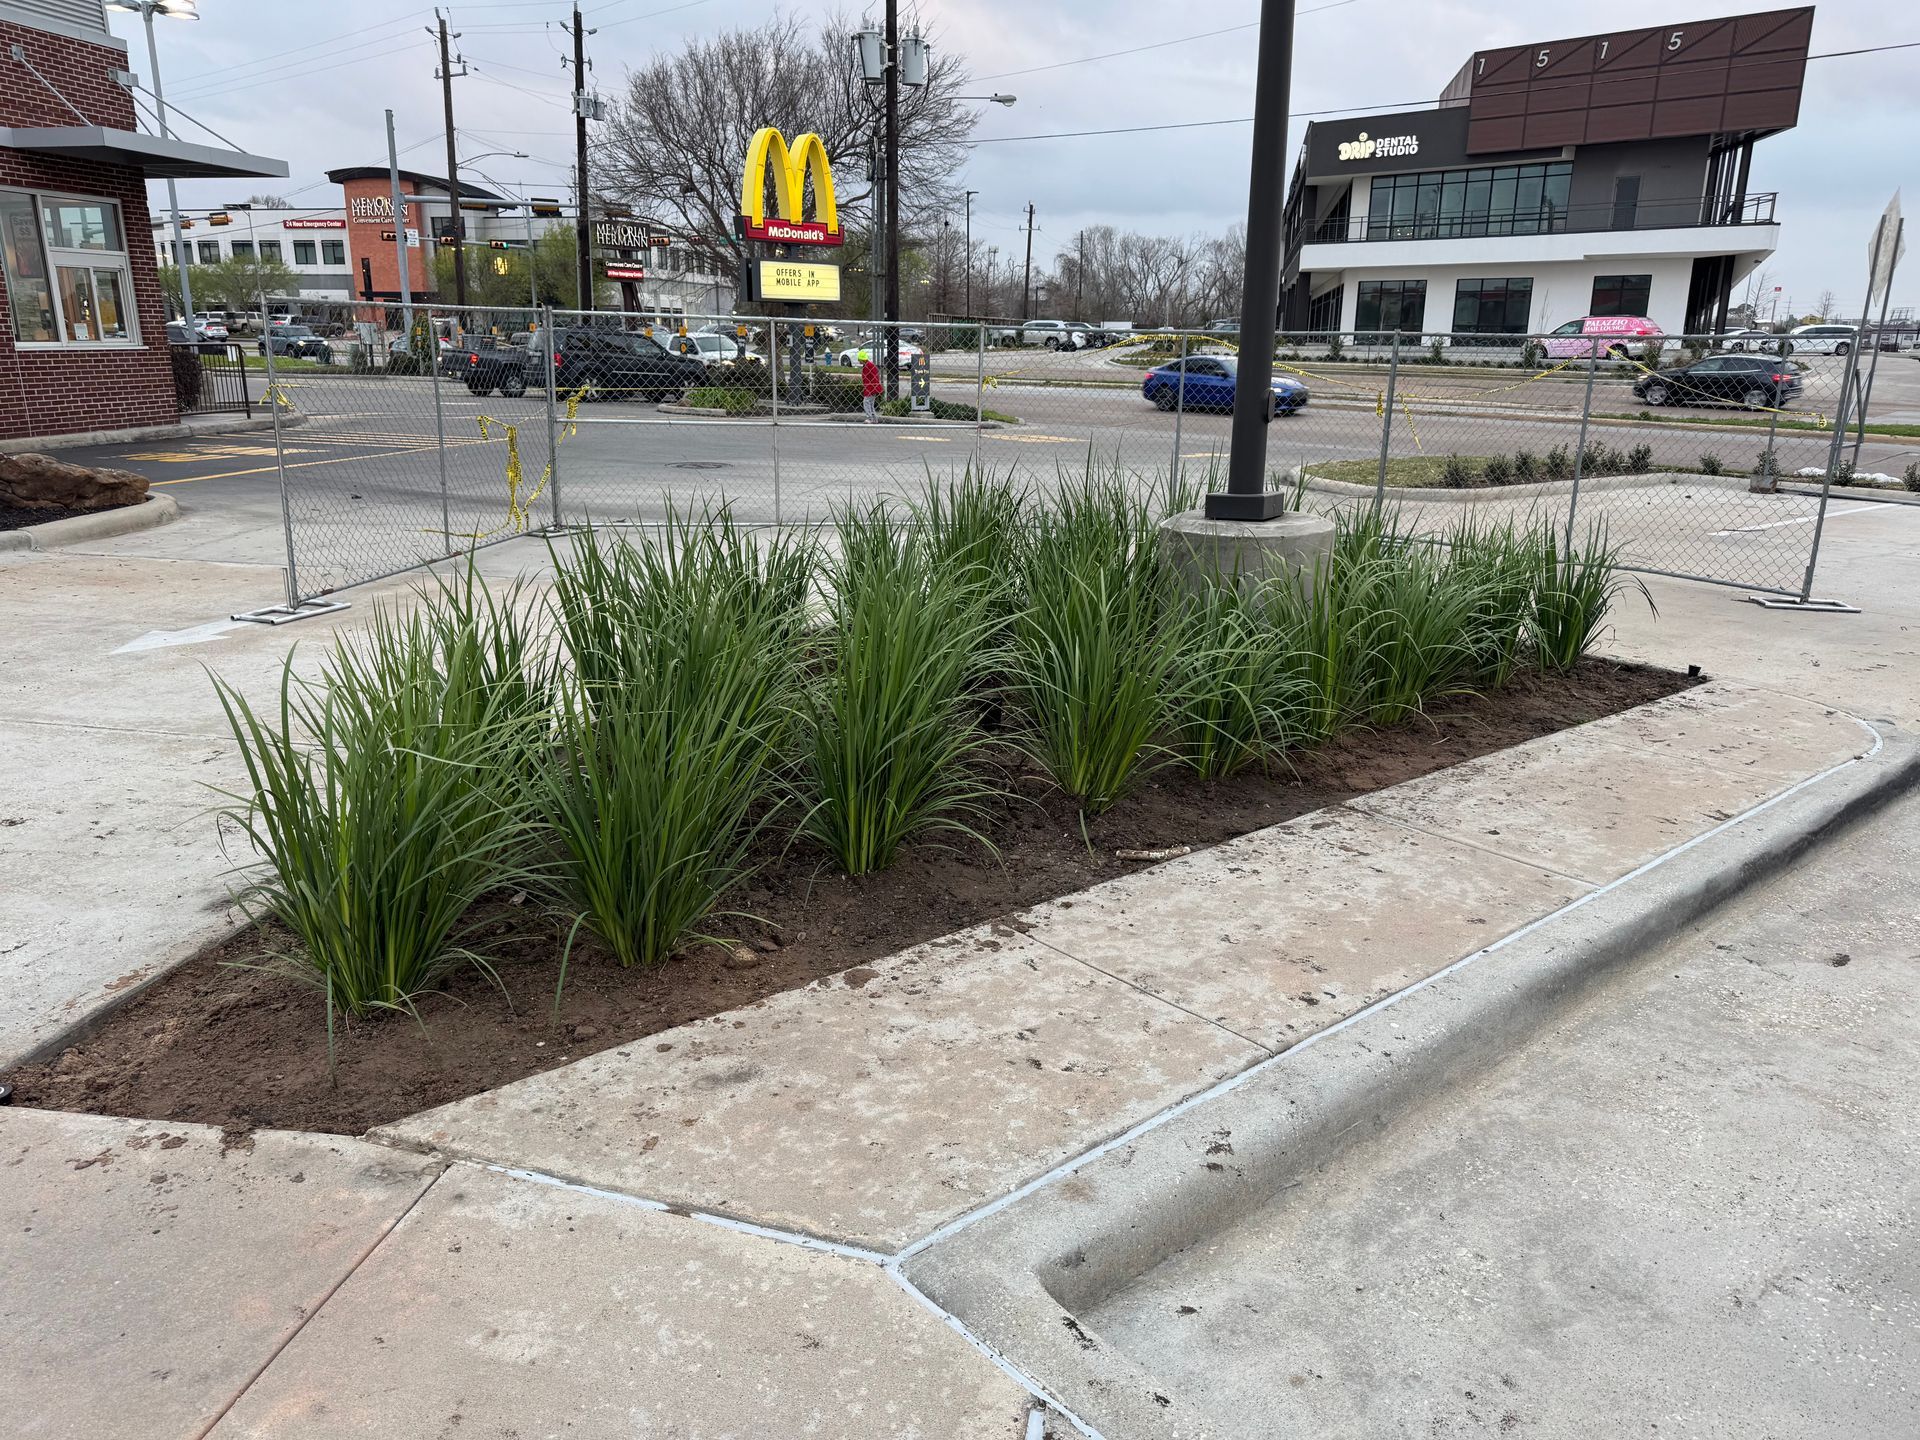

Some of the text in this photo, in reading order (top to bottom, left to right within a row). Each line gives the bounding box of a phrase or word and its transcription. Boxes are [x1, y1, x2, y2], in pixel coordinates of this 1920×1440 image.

[1536, 49, 1550, 68] 5
[1667, 31, 1684, 51] 5
[1338, 132, 1419, 160] DRIP DENTAL
[1375, 144, 1418, 158] STUDIO
[352, 196, 395, 208] MEMOR
[352, 205, 409, 217] HERMAN
[597, 223, 648, 238] MEMORIAL
[768, 226, 824, 240] McDonald's
[597, 232, 648, 247] HERMANN
[776, 268, 815, 278] OFFERS IN
[776, 278, 820, 287] MOBILE APP
[1585, 319, 1628, 327] PALAZZIO
